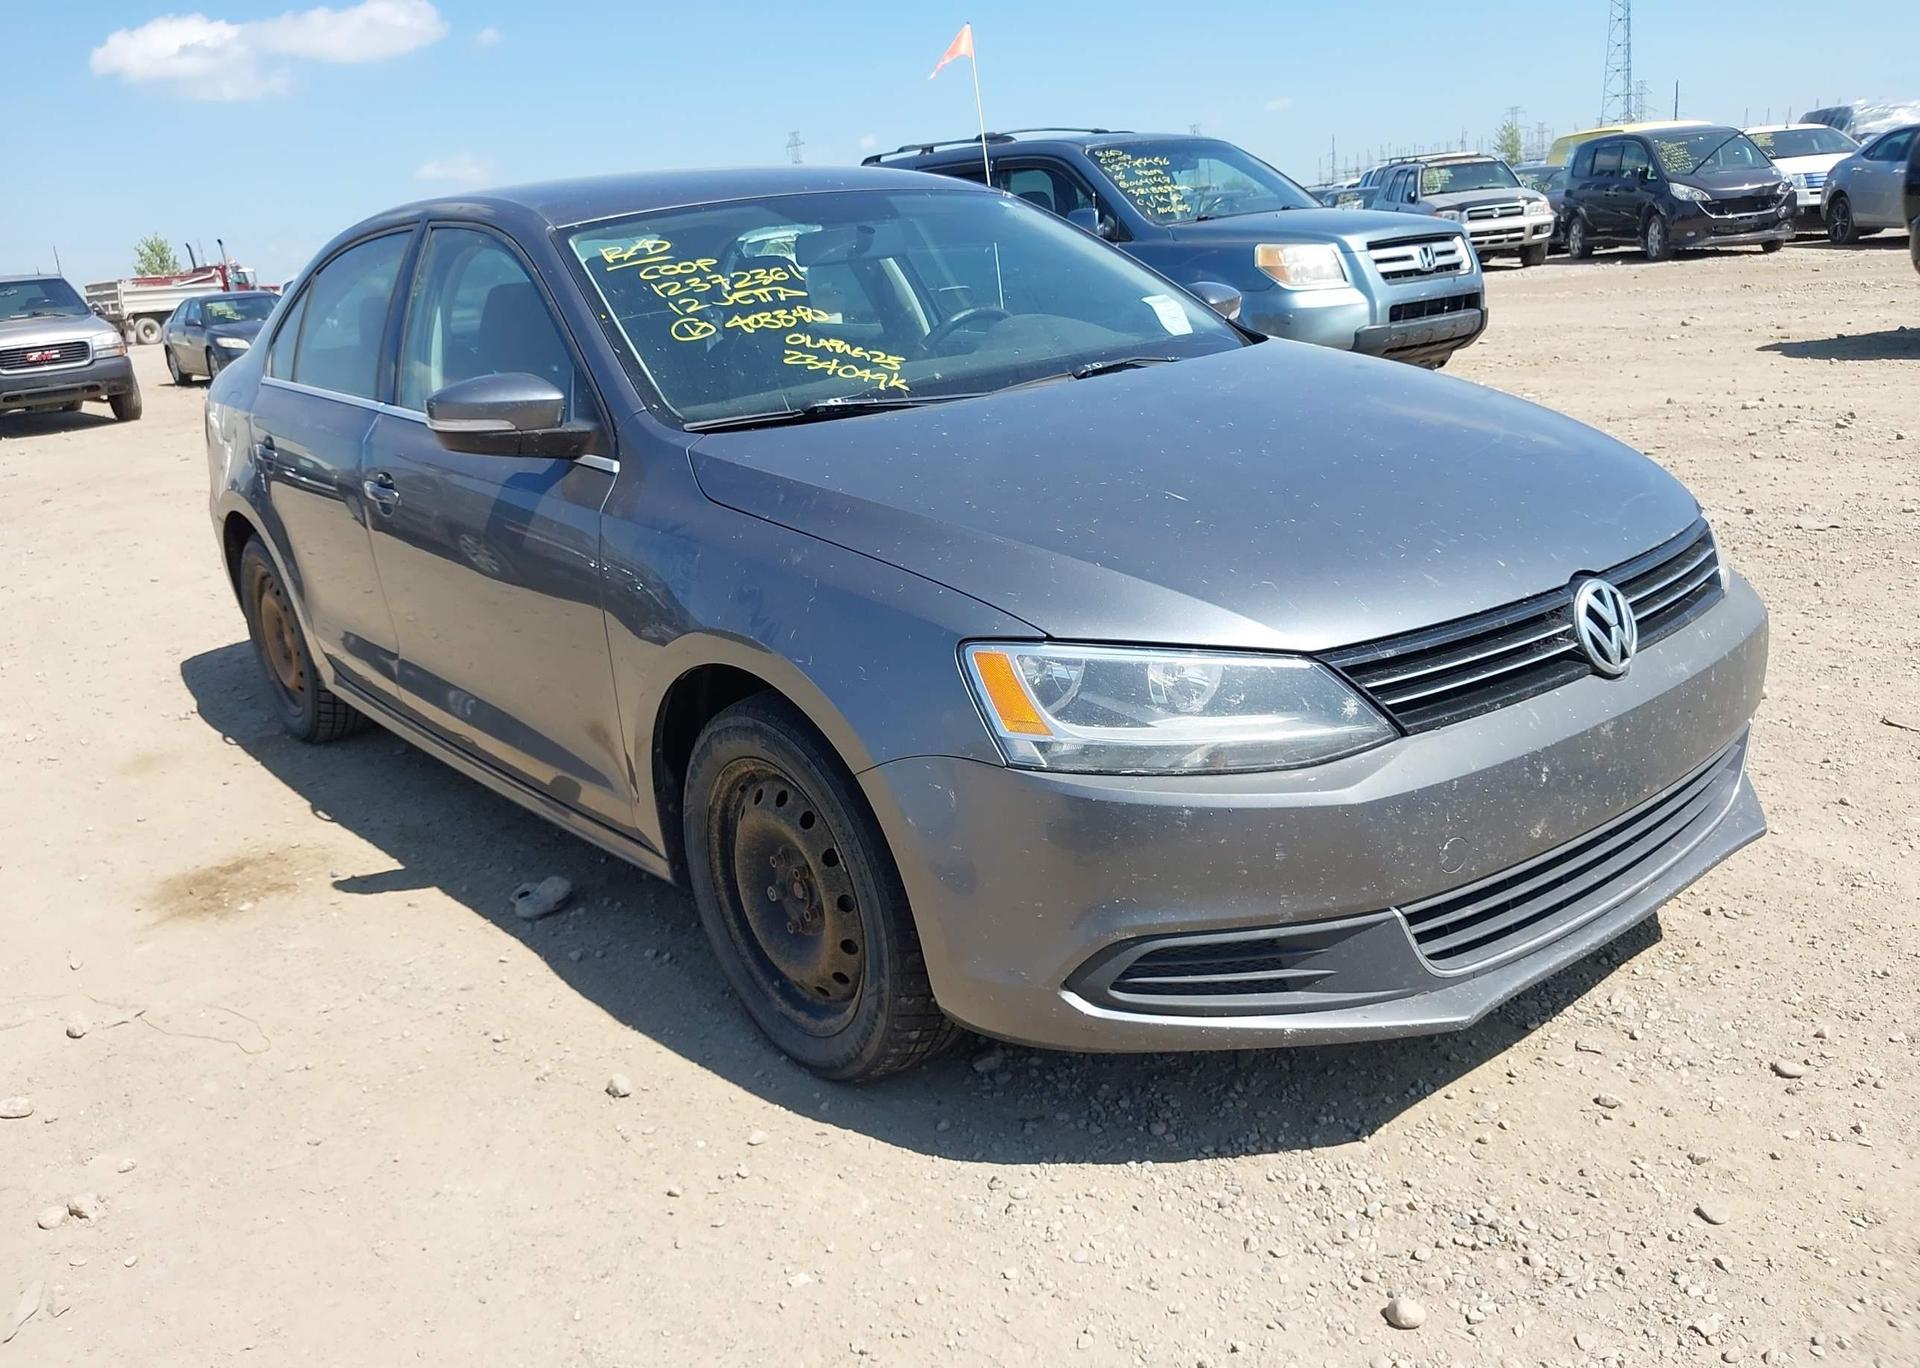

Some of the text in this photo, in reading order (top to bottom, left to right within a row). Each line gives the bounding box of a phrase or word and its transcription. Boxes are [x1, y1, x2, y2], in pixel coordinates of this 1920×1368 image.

[668, 286, 808, 316] 12 JETTA
[26, 349, 61, 362] GMC
